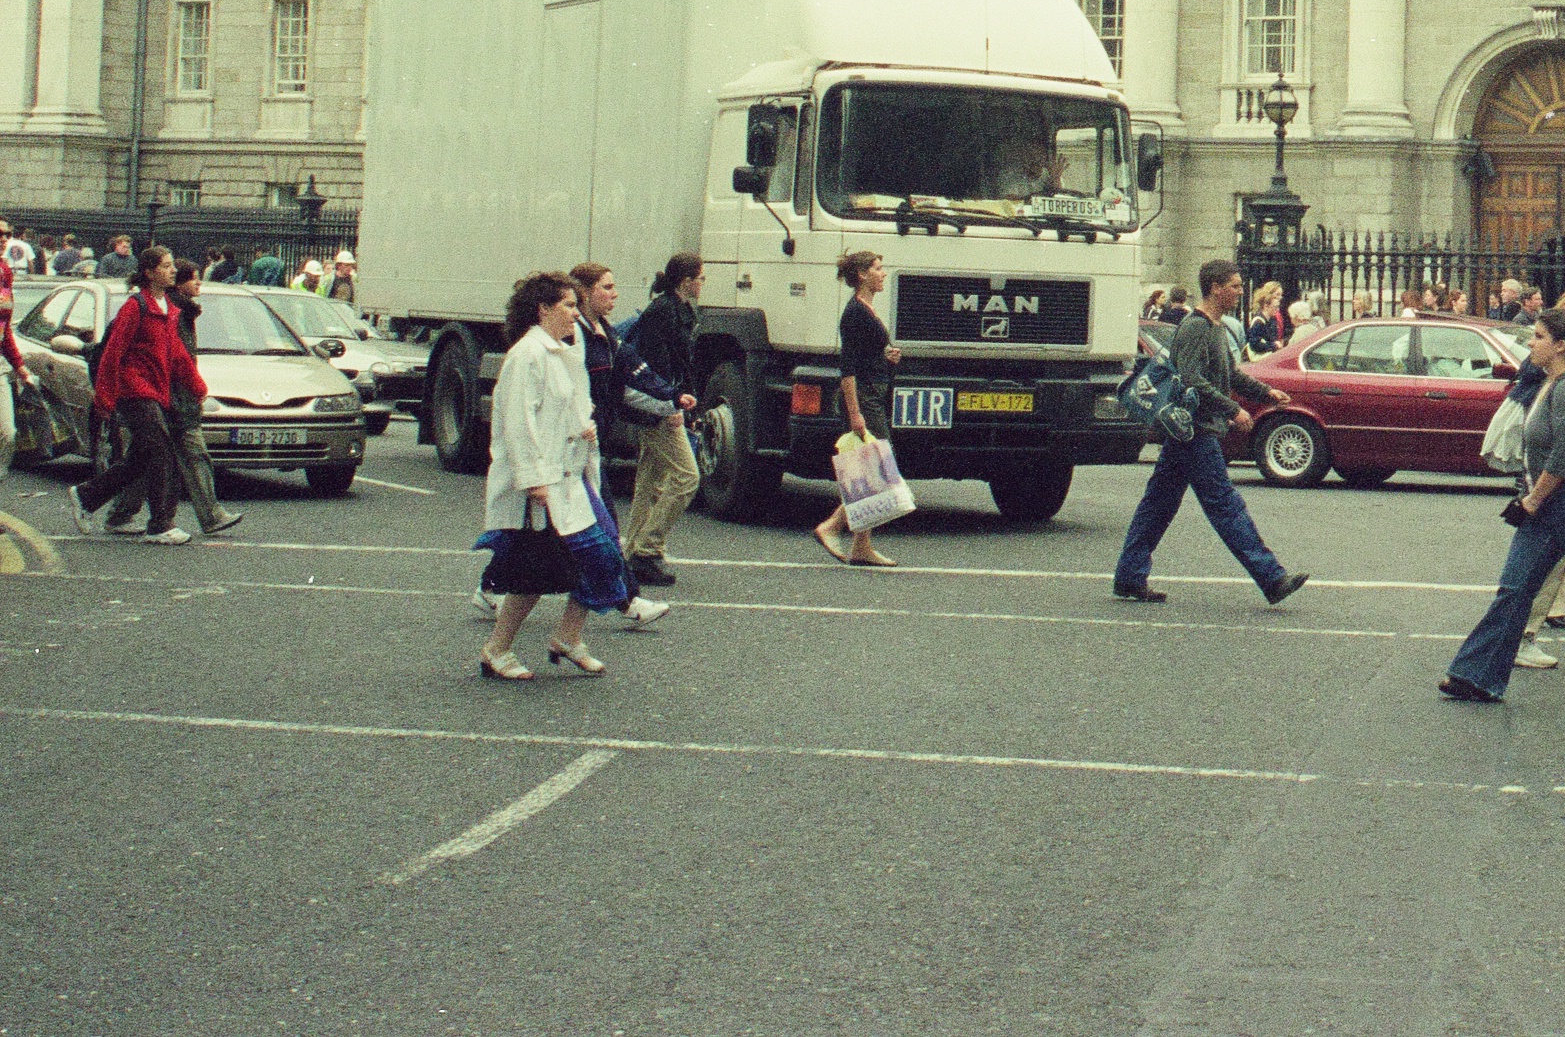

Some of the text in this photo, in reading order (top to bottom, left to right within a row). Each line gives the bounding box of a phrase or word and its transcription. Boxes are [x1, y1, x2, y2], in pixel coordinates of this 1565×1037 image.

[952, 294, 1039, 313] MAN
[898, 391, 948, 425] T.I.R.
[969, 394, 1031, 410] FLV-172
